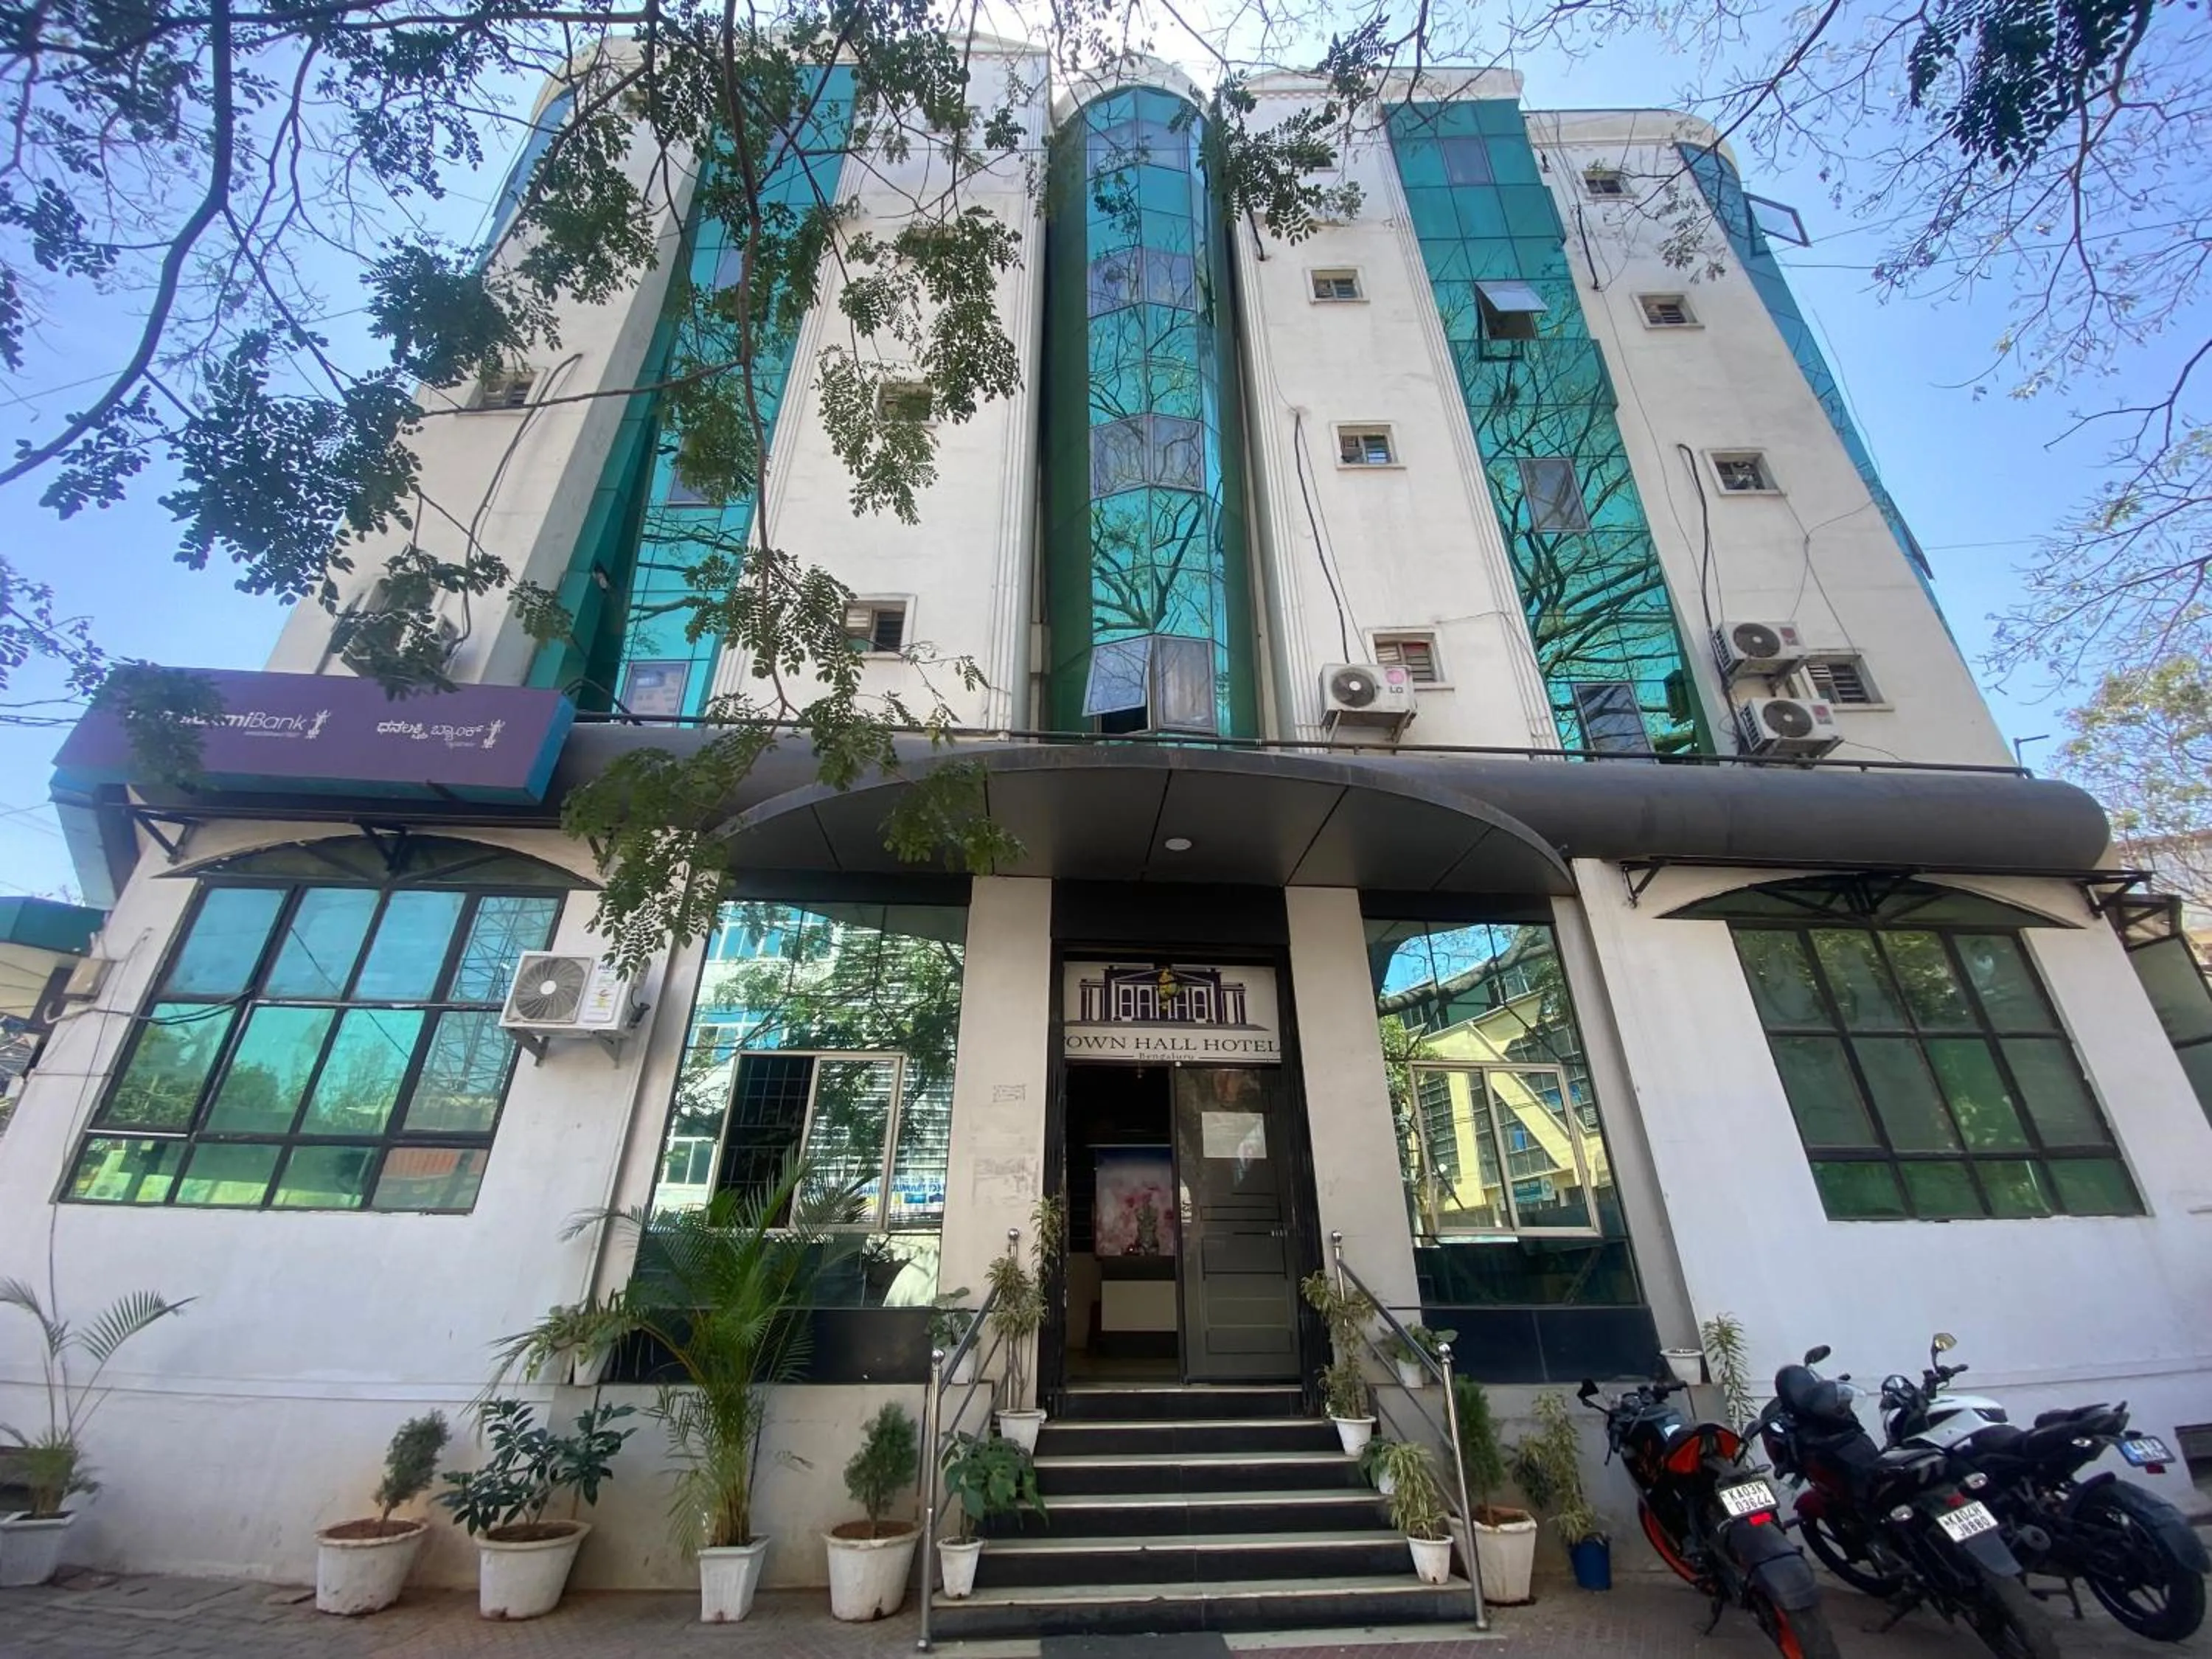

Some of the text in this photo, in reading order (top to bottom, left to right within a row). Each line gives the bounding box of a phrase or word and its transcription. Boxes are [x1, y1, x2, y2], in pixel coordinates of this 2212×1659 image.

[1063, 1035, 1281, 1052] OWN HALL HOTEL
[1139, 1052, 1194, 1060] Bengaluru
